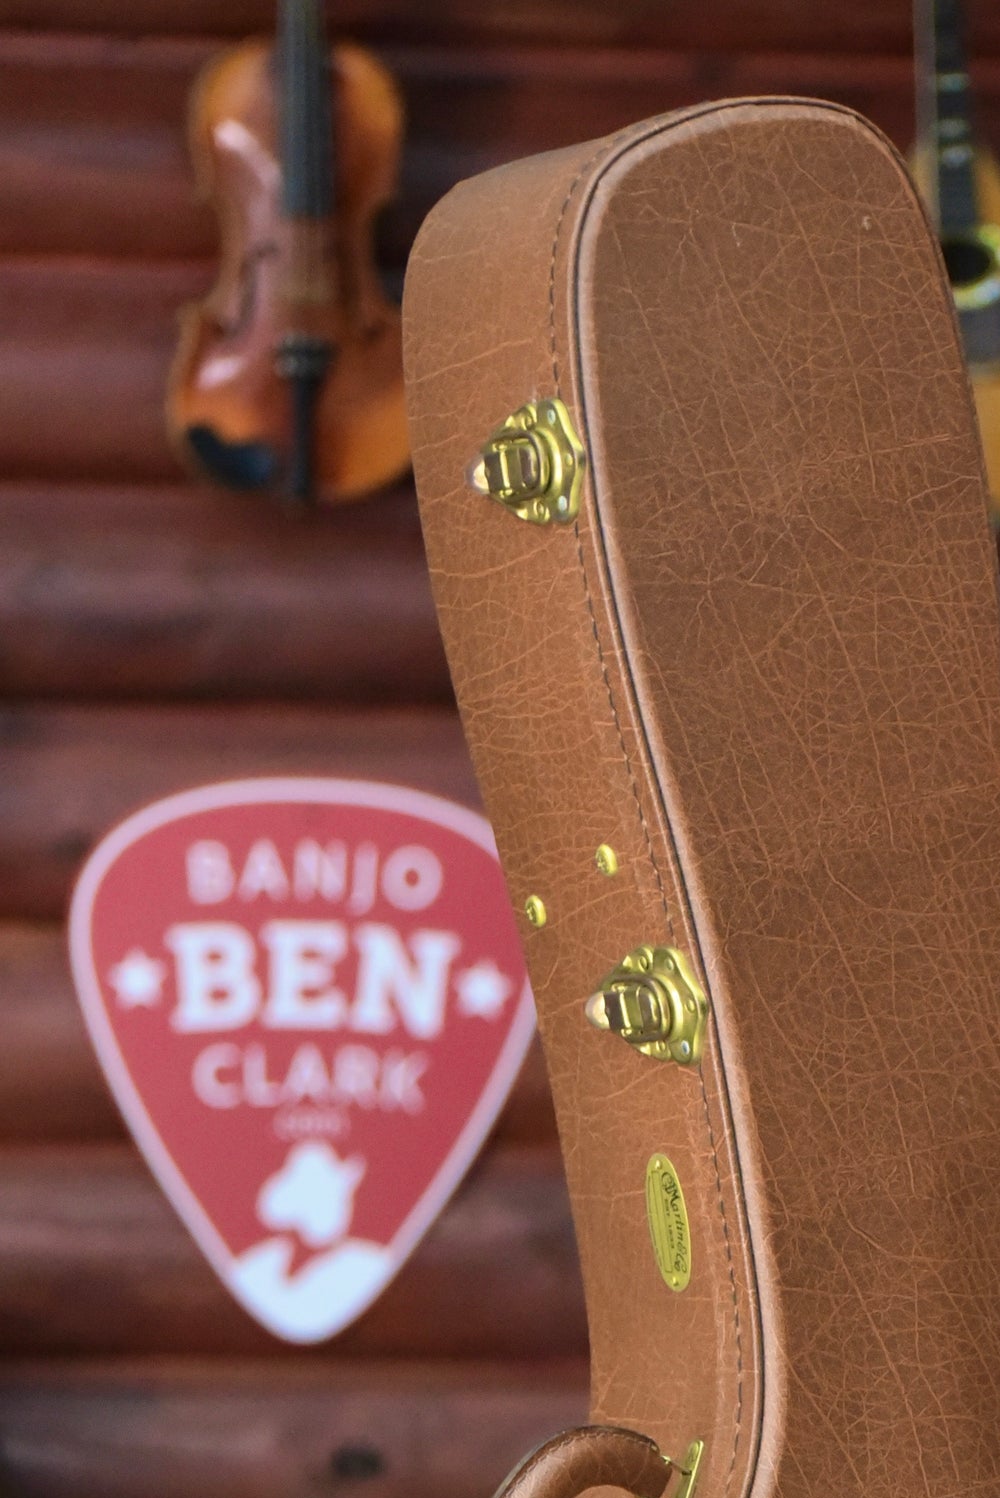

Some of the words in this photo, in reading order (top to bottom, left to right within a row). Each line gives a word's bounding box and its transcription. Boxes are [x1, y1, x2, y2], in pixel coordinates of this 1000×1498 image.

[185, 838, 444, 914] BANJO
[163, 918, 462, 1040] BEN
[191, 1042, 428, 1115] CLARK
